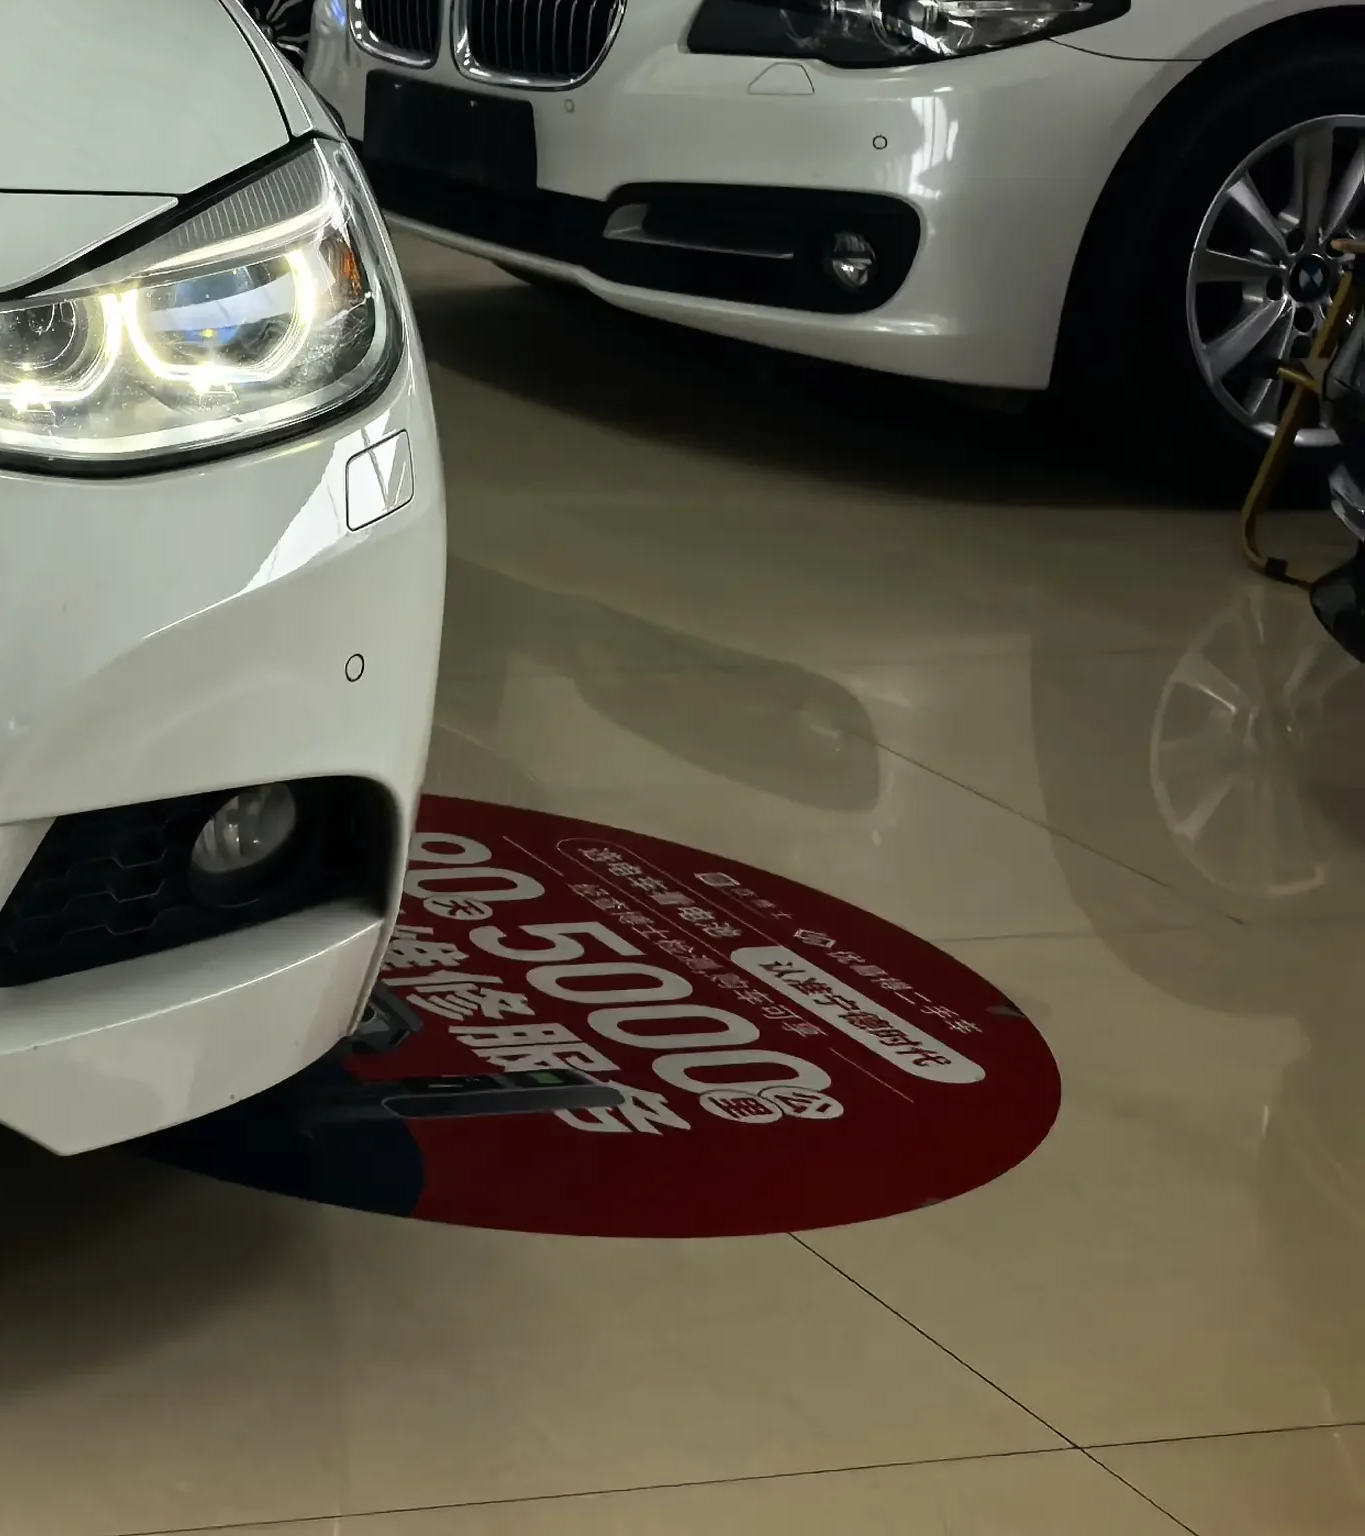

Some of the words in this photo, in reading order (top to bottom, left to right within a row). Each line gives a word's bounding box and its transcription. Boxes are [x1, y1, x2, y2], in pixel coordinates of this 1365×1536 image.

[762, 959, 953, 1068] 认准宁德时代
[829, 950, 983, 1034] 优易得二手车
